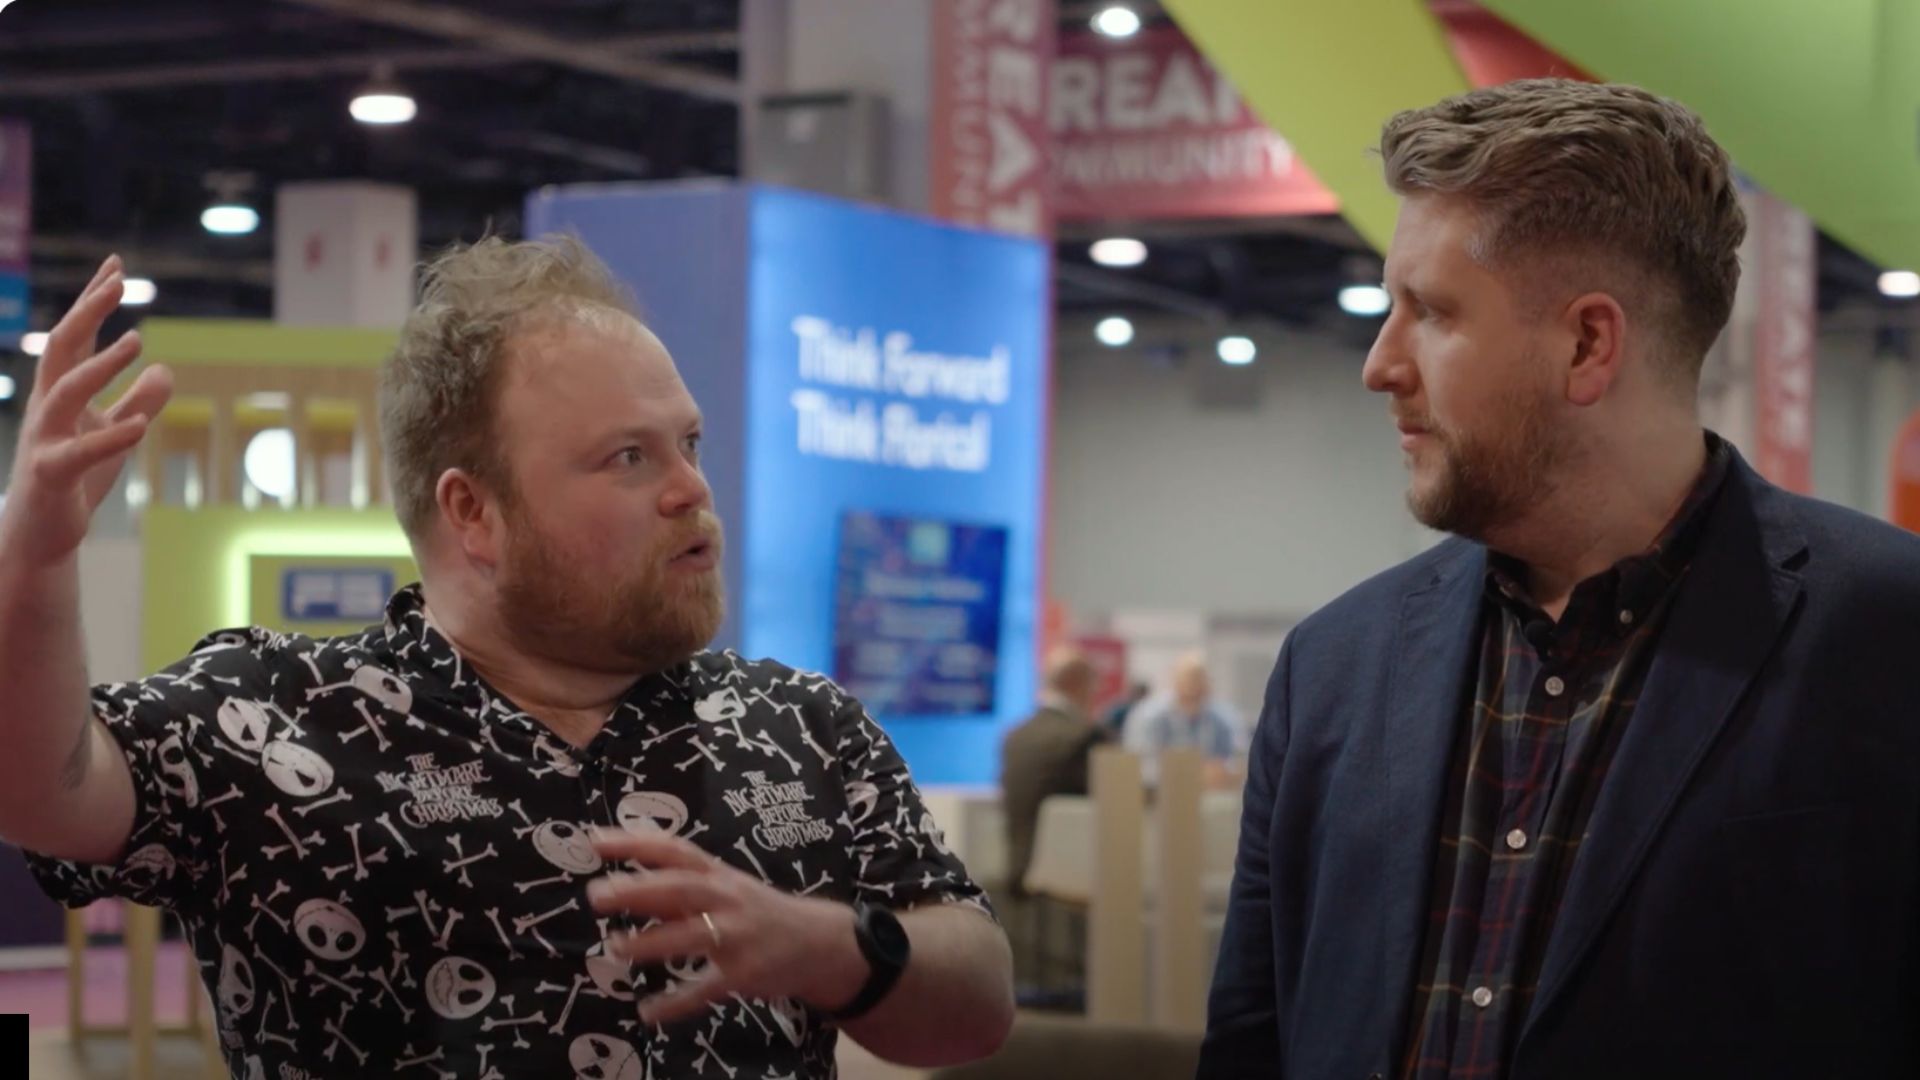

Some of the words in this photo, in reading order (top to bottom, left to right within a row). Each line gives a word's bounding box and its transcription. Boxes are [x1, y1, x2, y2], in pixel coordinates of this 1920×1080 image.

[790, 315, 880, 391] Think
[789, 387, 879, 463] Think
[405, 752, 440, 771] THE
[741, 770, 773, 786] THE
[411, 783, 481, 803] BEFORE
[400, 798, 504, 829] CHRISTMAS
[756, 802, 812, 827] BEFORE
[752, 818, 834, 851] CHRISTMAS
